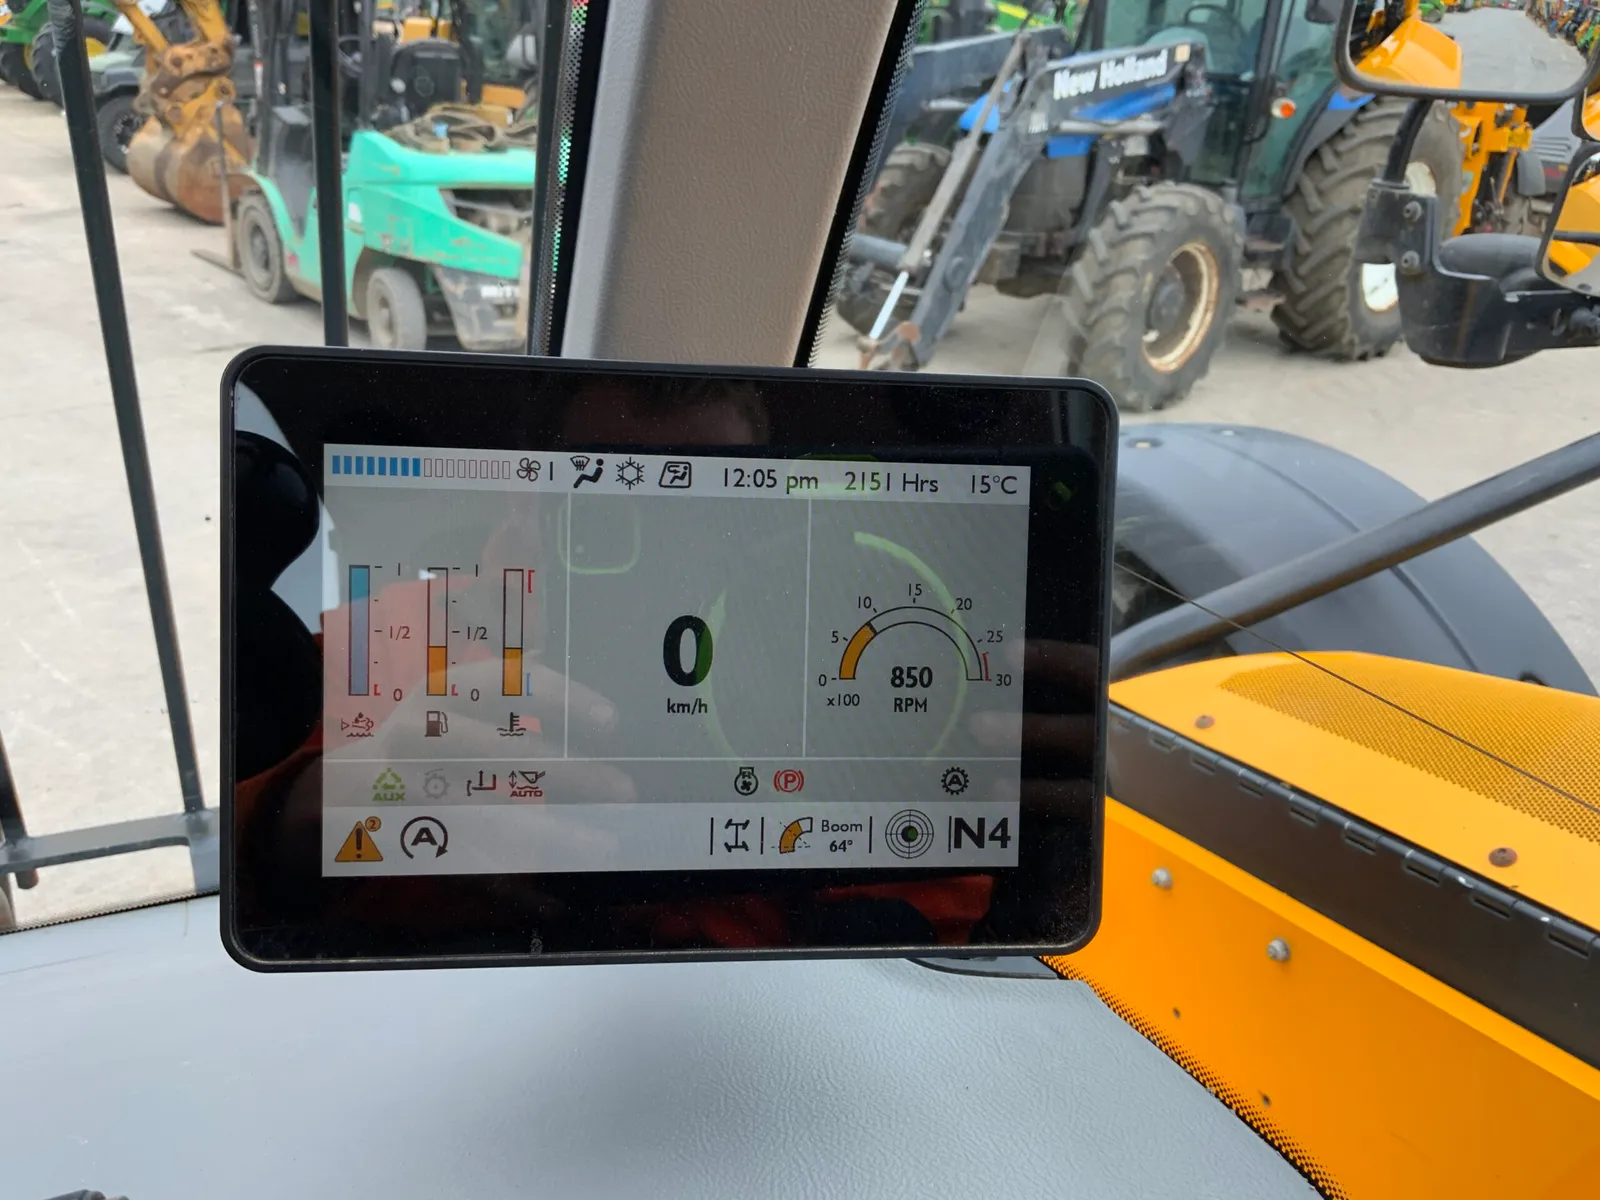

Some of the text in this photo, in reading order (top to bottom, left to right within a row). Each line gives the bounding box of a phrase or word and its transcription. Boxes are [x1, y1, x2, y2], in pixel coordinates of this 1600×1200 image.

[1053, 49, 1168, 100] New Holland
[723, 468, 819, 494] 12:05 pm
[844, 472, 938, 493] 2151 Hrs
[972, 475, 1017, 494] 15°C
[908, 583, 922, 596] 15
[858, 597, 872, 609] 10
[956, 598, 972, 611] 20
[389, 626, 411, 640] 1/2
[467, 627, 488, 640] 1/2
[831, 631, 839, 643] 5
[987, 630, 1003, 642] 25
[663, 614, 713, 687] 0
[819, 674, 827, 686] 0
[890, 666, 933, 688] 850
[996, 674, 1012, 687] 30
[393, 689, 402, 701] 0
[471, 689, 479, 701] 0
[827, 694, 860, 707] x100
[667, 698, 708, 714] km/h
[894, 698, 927, 713] RPM
[372, 792, 406, 802] AUX
[510, 790, 544, 798] AUTO
[822, 821, 862, 832] Boom
[954, 818, 1011, 848] N4
[829, 840, 853, 852] 64°
